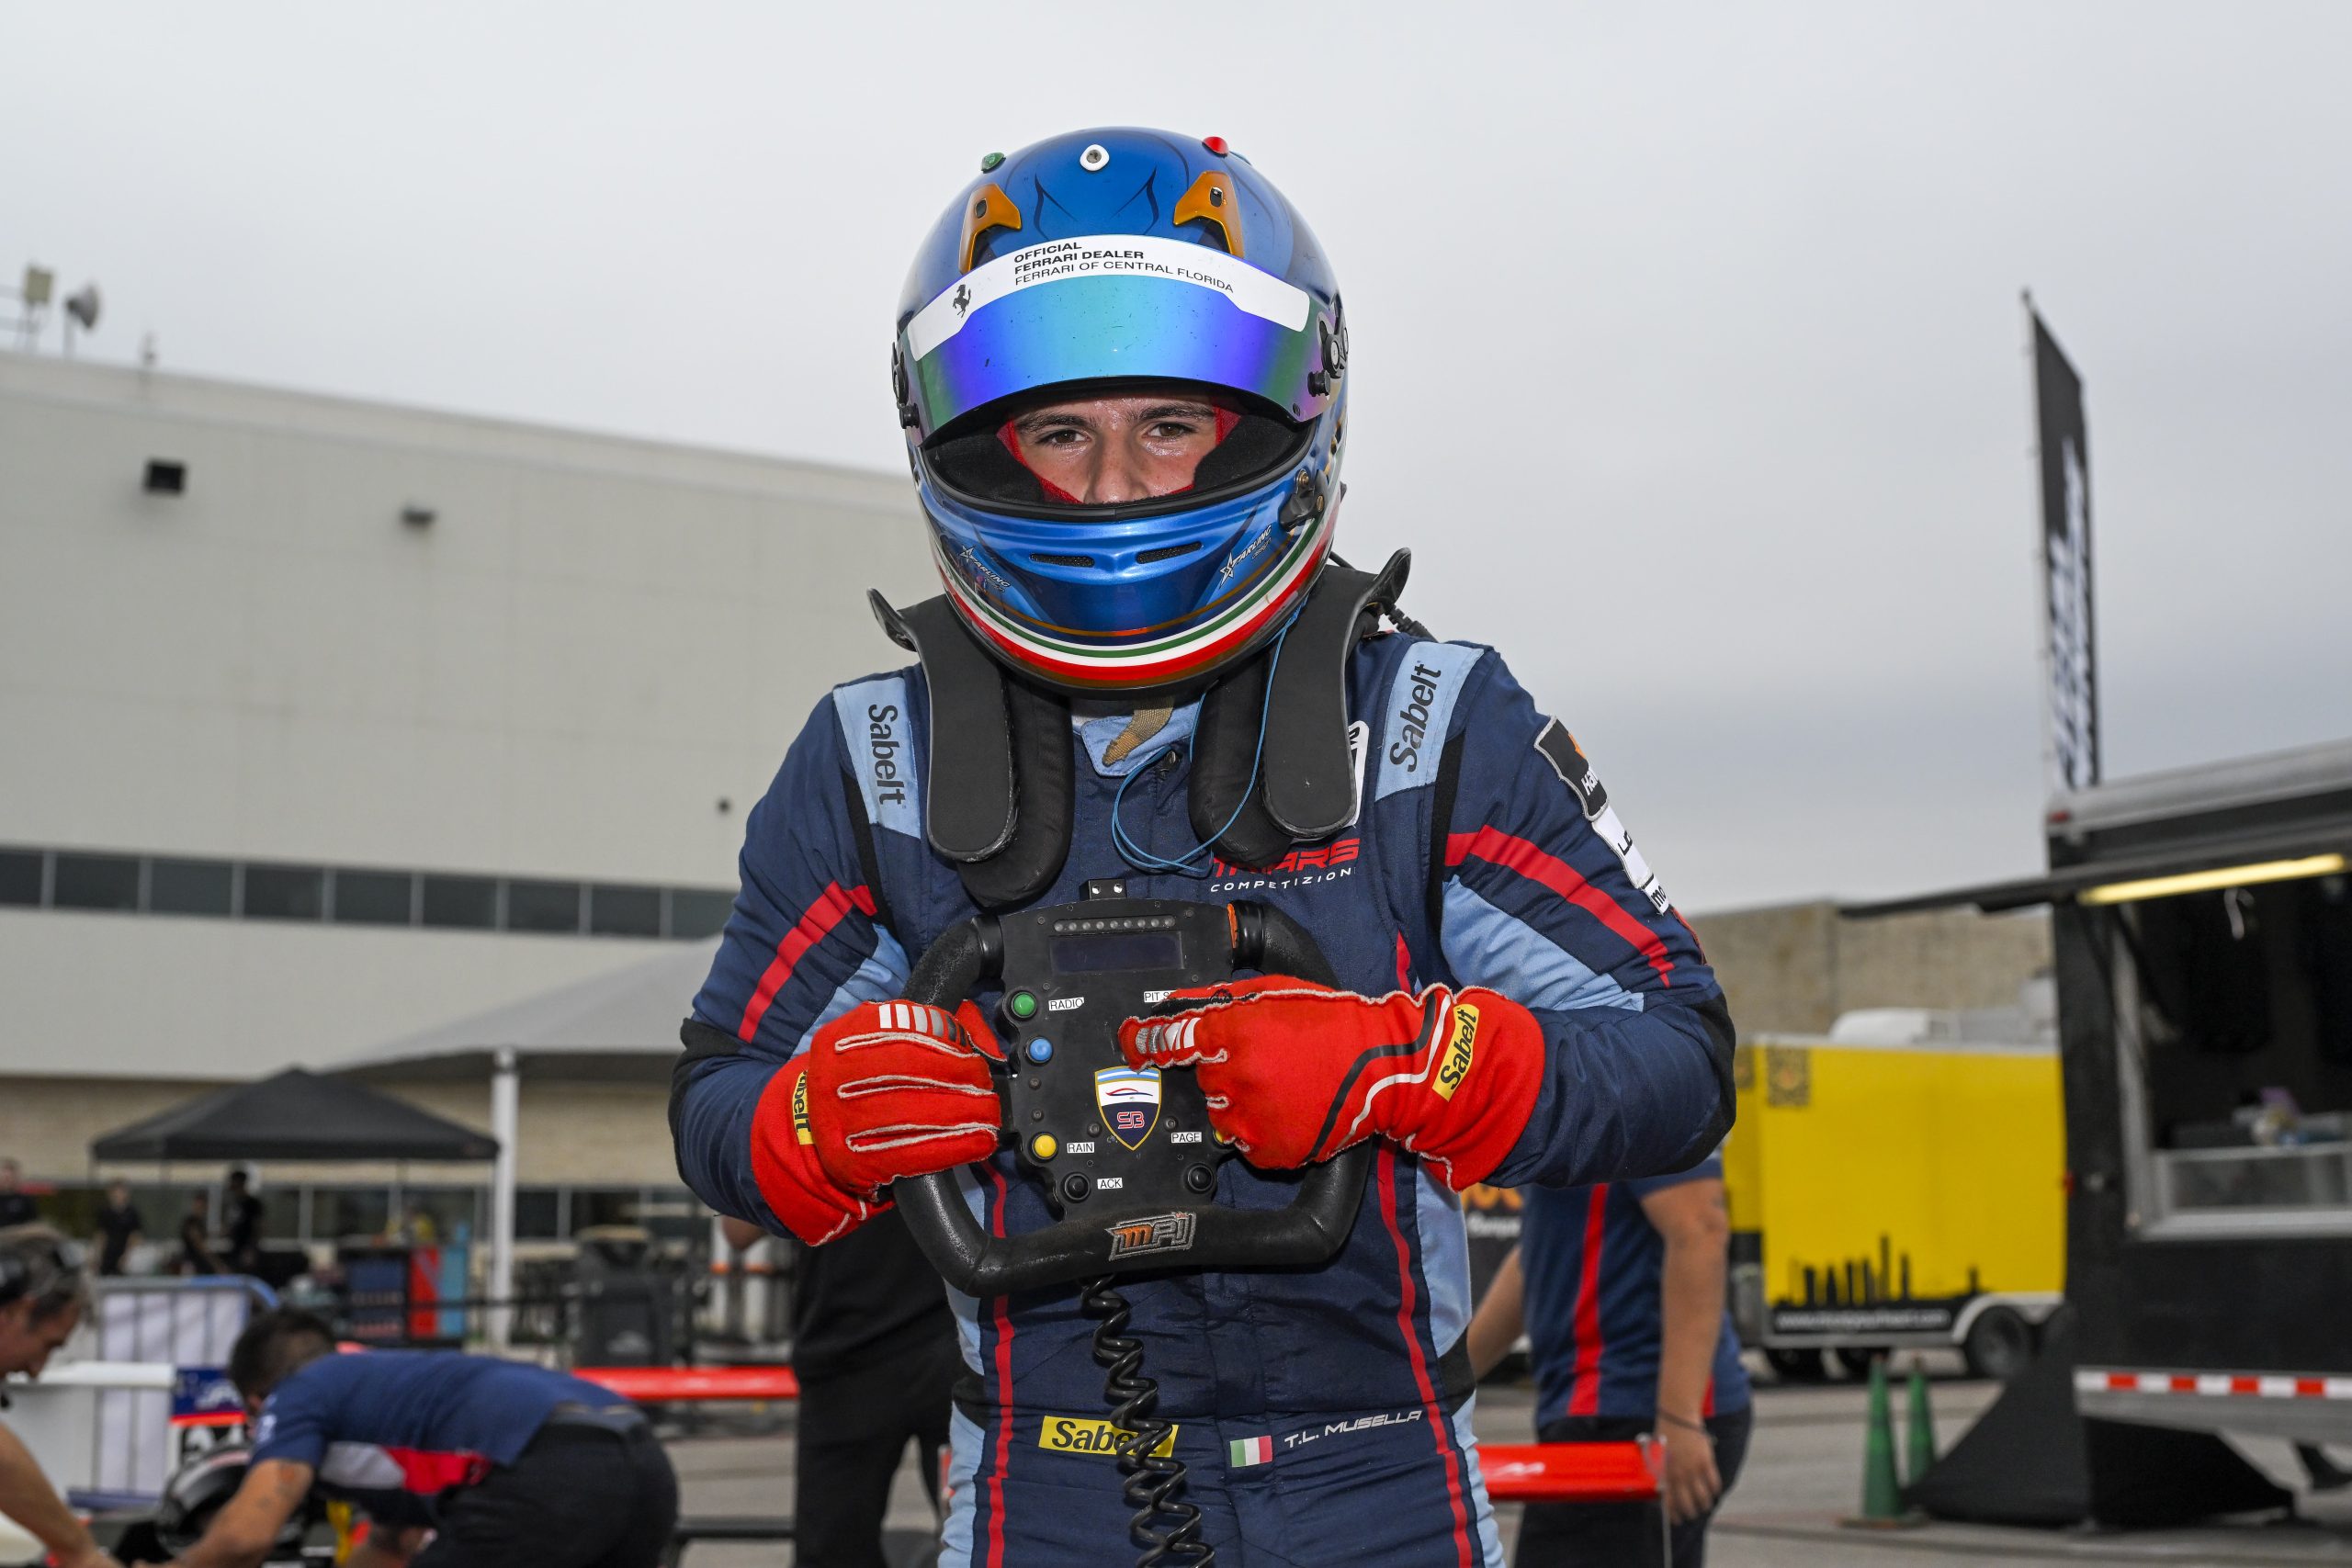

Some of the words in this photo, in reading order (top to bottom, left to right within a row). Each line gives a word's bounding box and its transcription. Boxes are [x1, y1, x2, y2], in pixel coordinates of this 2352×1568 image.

[1013, 242, 1082, 263] OFFICIAL
[1014, 253, 1078, 275] FERRARI
[1081, 251, 1144, 260] DEALER
[1015, 264, 1074, 286] FERRARI
[1079, 262, 1099, 271] OF
[1103, 261, 1174, 275] CENTRAL
[1177, 267, 1234, 293] FLORIDA
[1389, 663, 1442, 773] Sabelt
[867, 704, 906, 806] Sabelt
[1050, 998, 1084, 1010] RADIO
[1144, 992, 1159, 1001] PIT
[1440, 1009, 1476, 1090] Sabelt
[1067, 1143, 1093, 1153] RAIN
[1171, 1132, 1201, 1143] PAGE
[1100, 1179, 1122, 1189] ACK
[1051, 1420, 1157, 1454] Sabe
[1284, 1430, 1319, 1449] T.L.
[1324, 1410, 1422, 1437] MUSELLA
